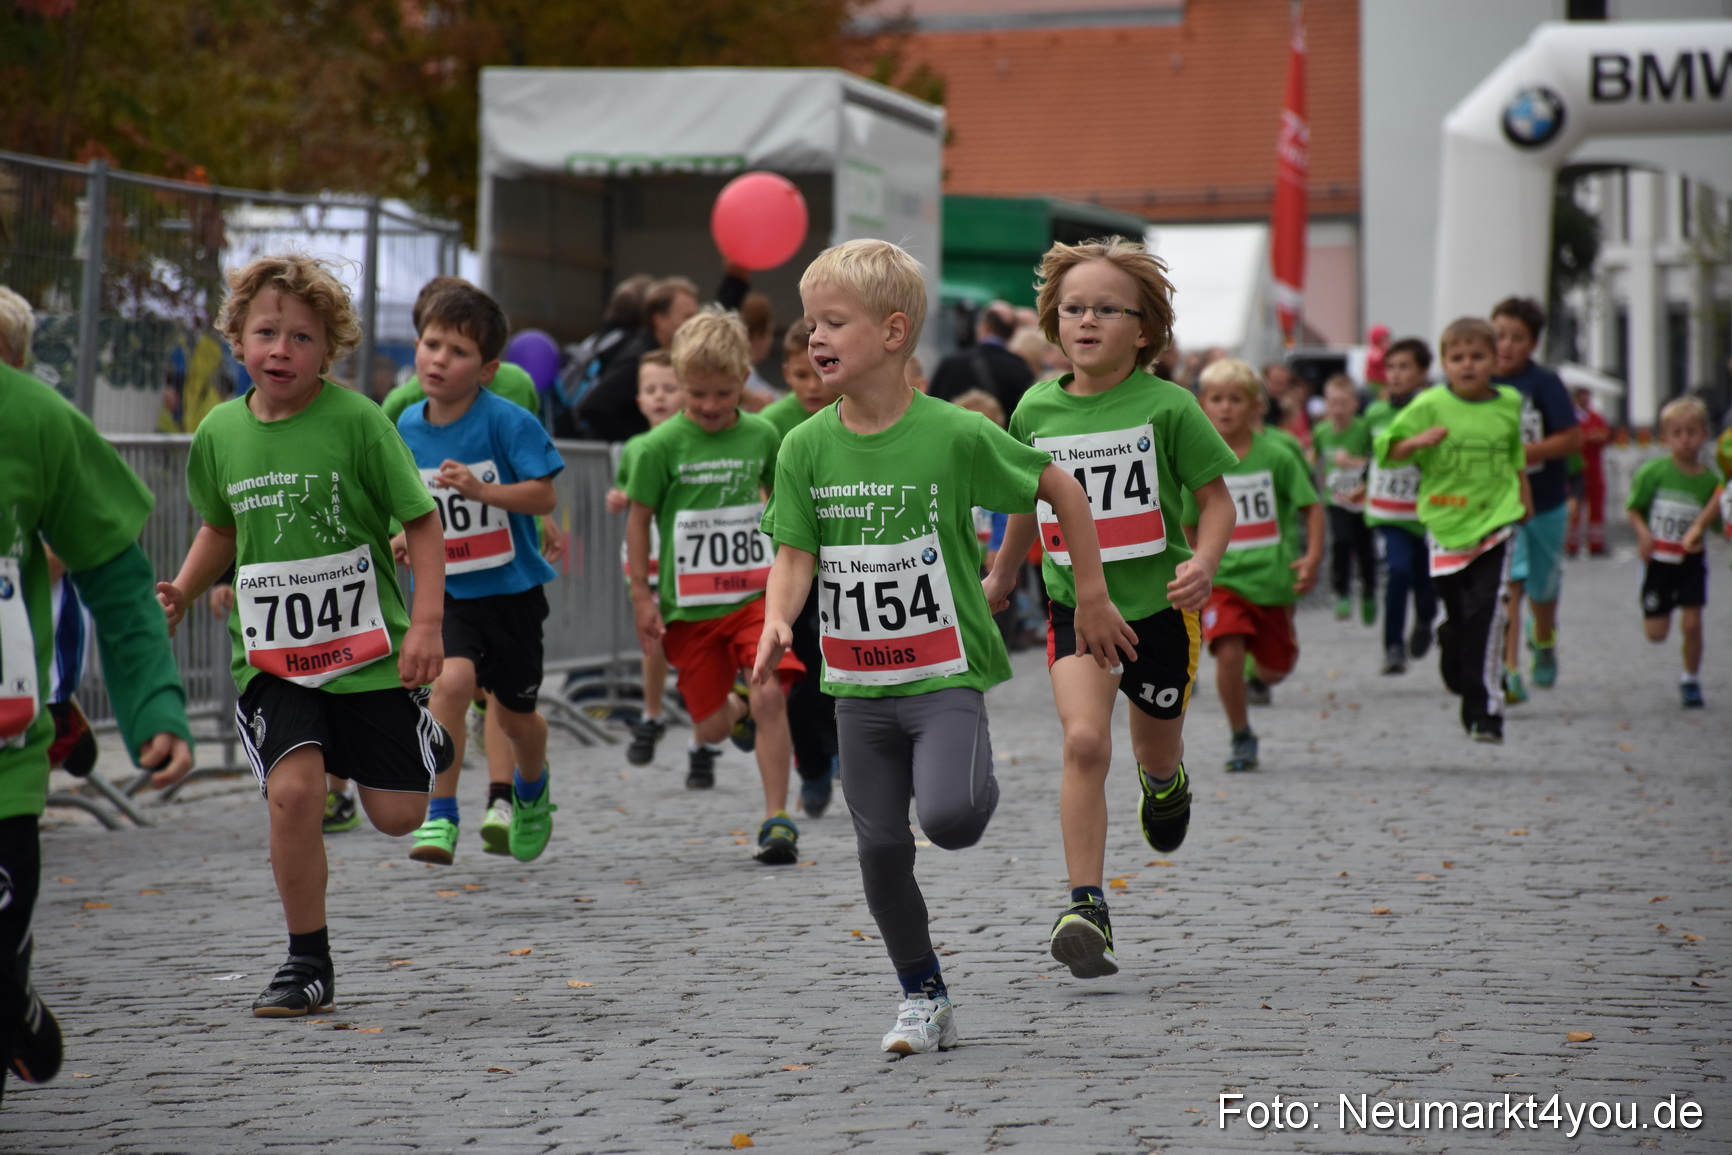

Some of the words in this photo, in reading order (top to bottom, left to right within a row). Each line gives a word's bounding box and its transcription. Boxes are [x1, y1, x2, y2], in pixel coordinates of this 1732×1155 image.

[1069, 443, 1132, 460] Neumarkt
[226, 471, 299, 497] Neumarkter
[816, 502, 875, 521] adtlauf
[445, 542, 470, 558] aul
[686, 528, 764, 568] 7086
[240, 575, 286, 590] PARTL
[289, 565, 354, 586] Neumarkt
[850, 557, 917, 573] Neumarkt
[714, 576, 748, 591] Felix
[253, 580, 366, 642] 7047
[823, 573, 941, 632] 7154
[285, 647, 354, 673] Hannes
[851, 646, 917, 667] Tobias
[1138, 682, 1179, 709] 10
